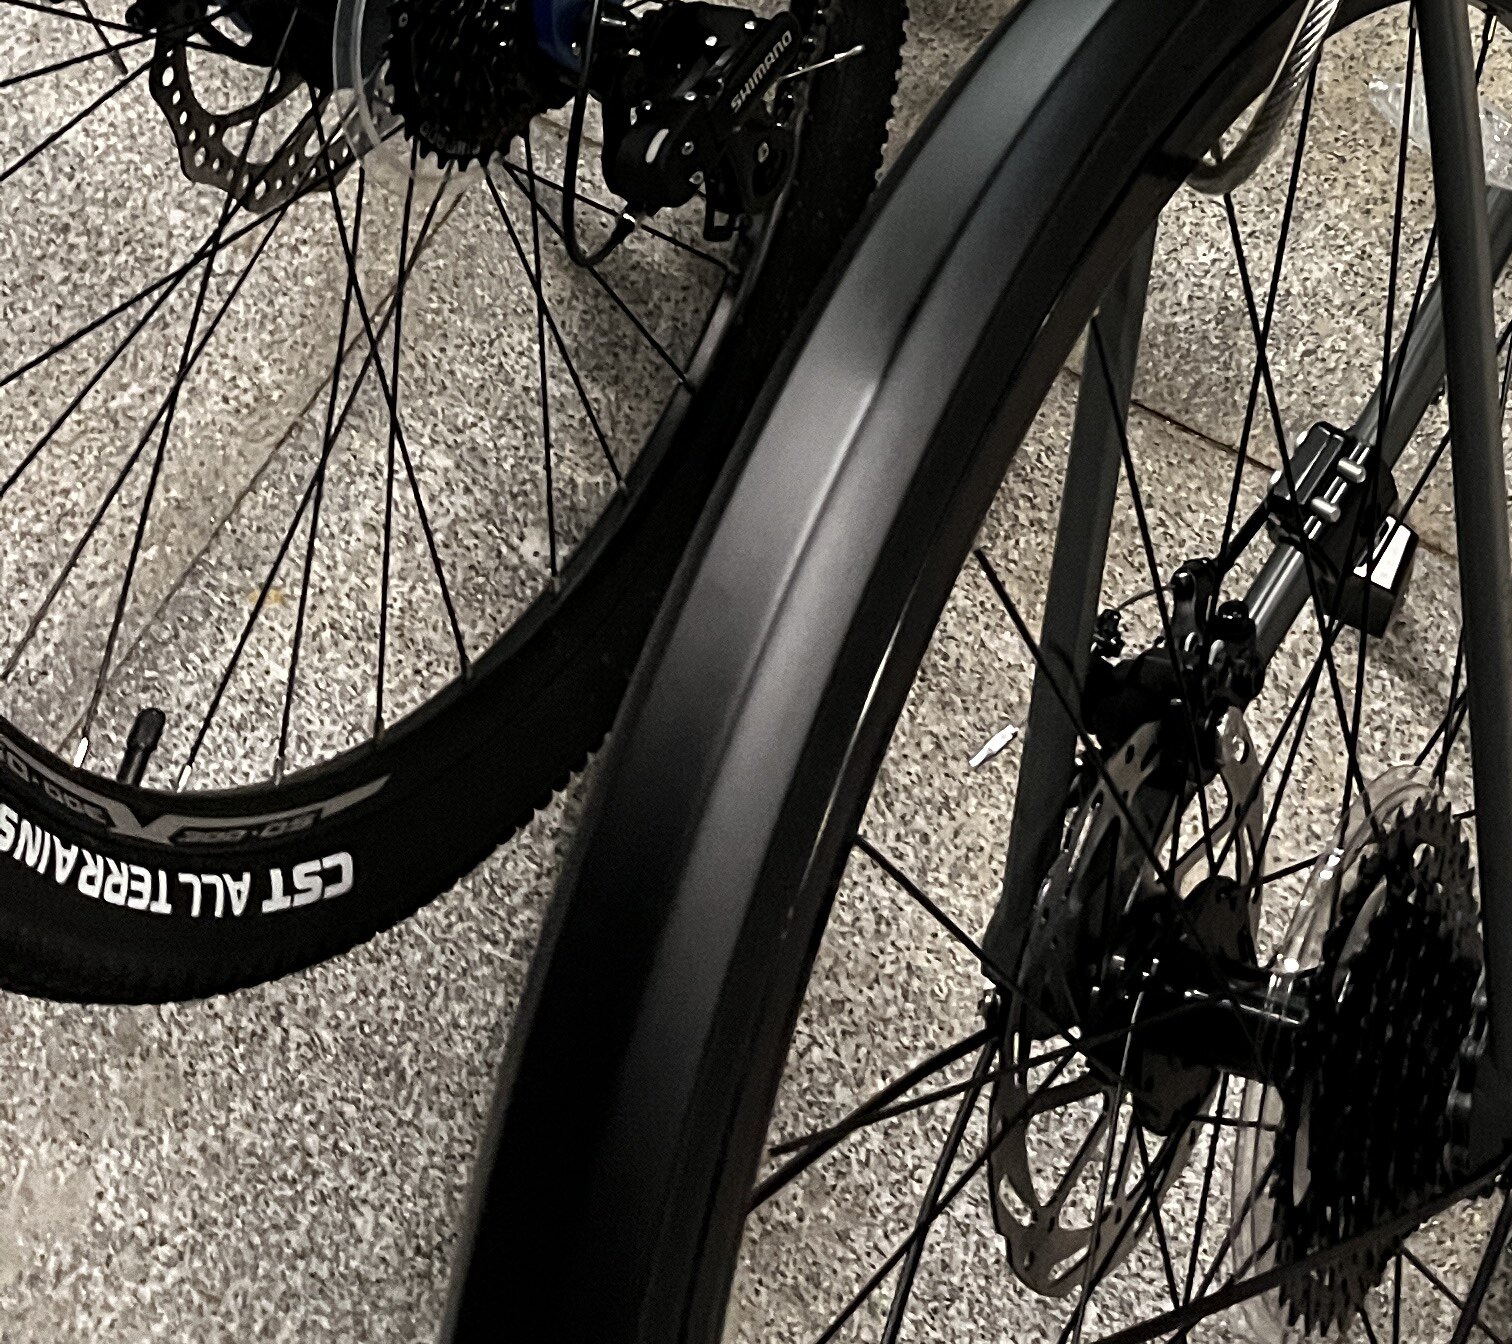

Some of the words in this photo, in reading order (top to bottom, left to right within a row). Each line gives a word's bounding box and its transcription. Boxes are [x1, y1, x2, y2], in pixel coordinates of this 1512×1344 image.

[730, 29, 794, 113] SHIMANO
[0, 803, 173, 915] TERRAINS
[179, 870, 252, 919] ALL
[261, 850, 355, 914] CST
